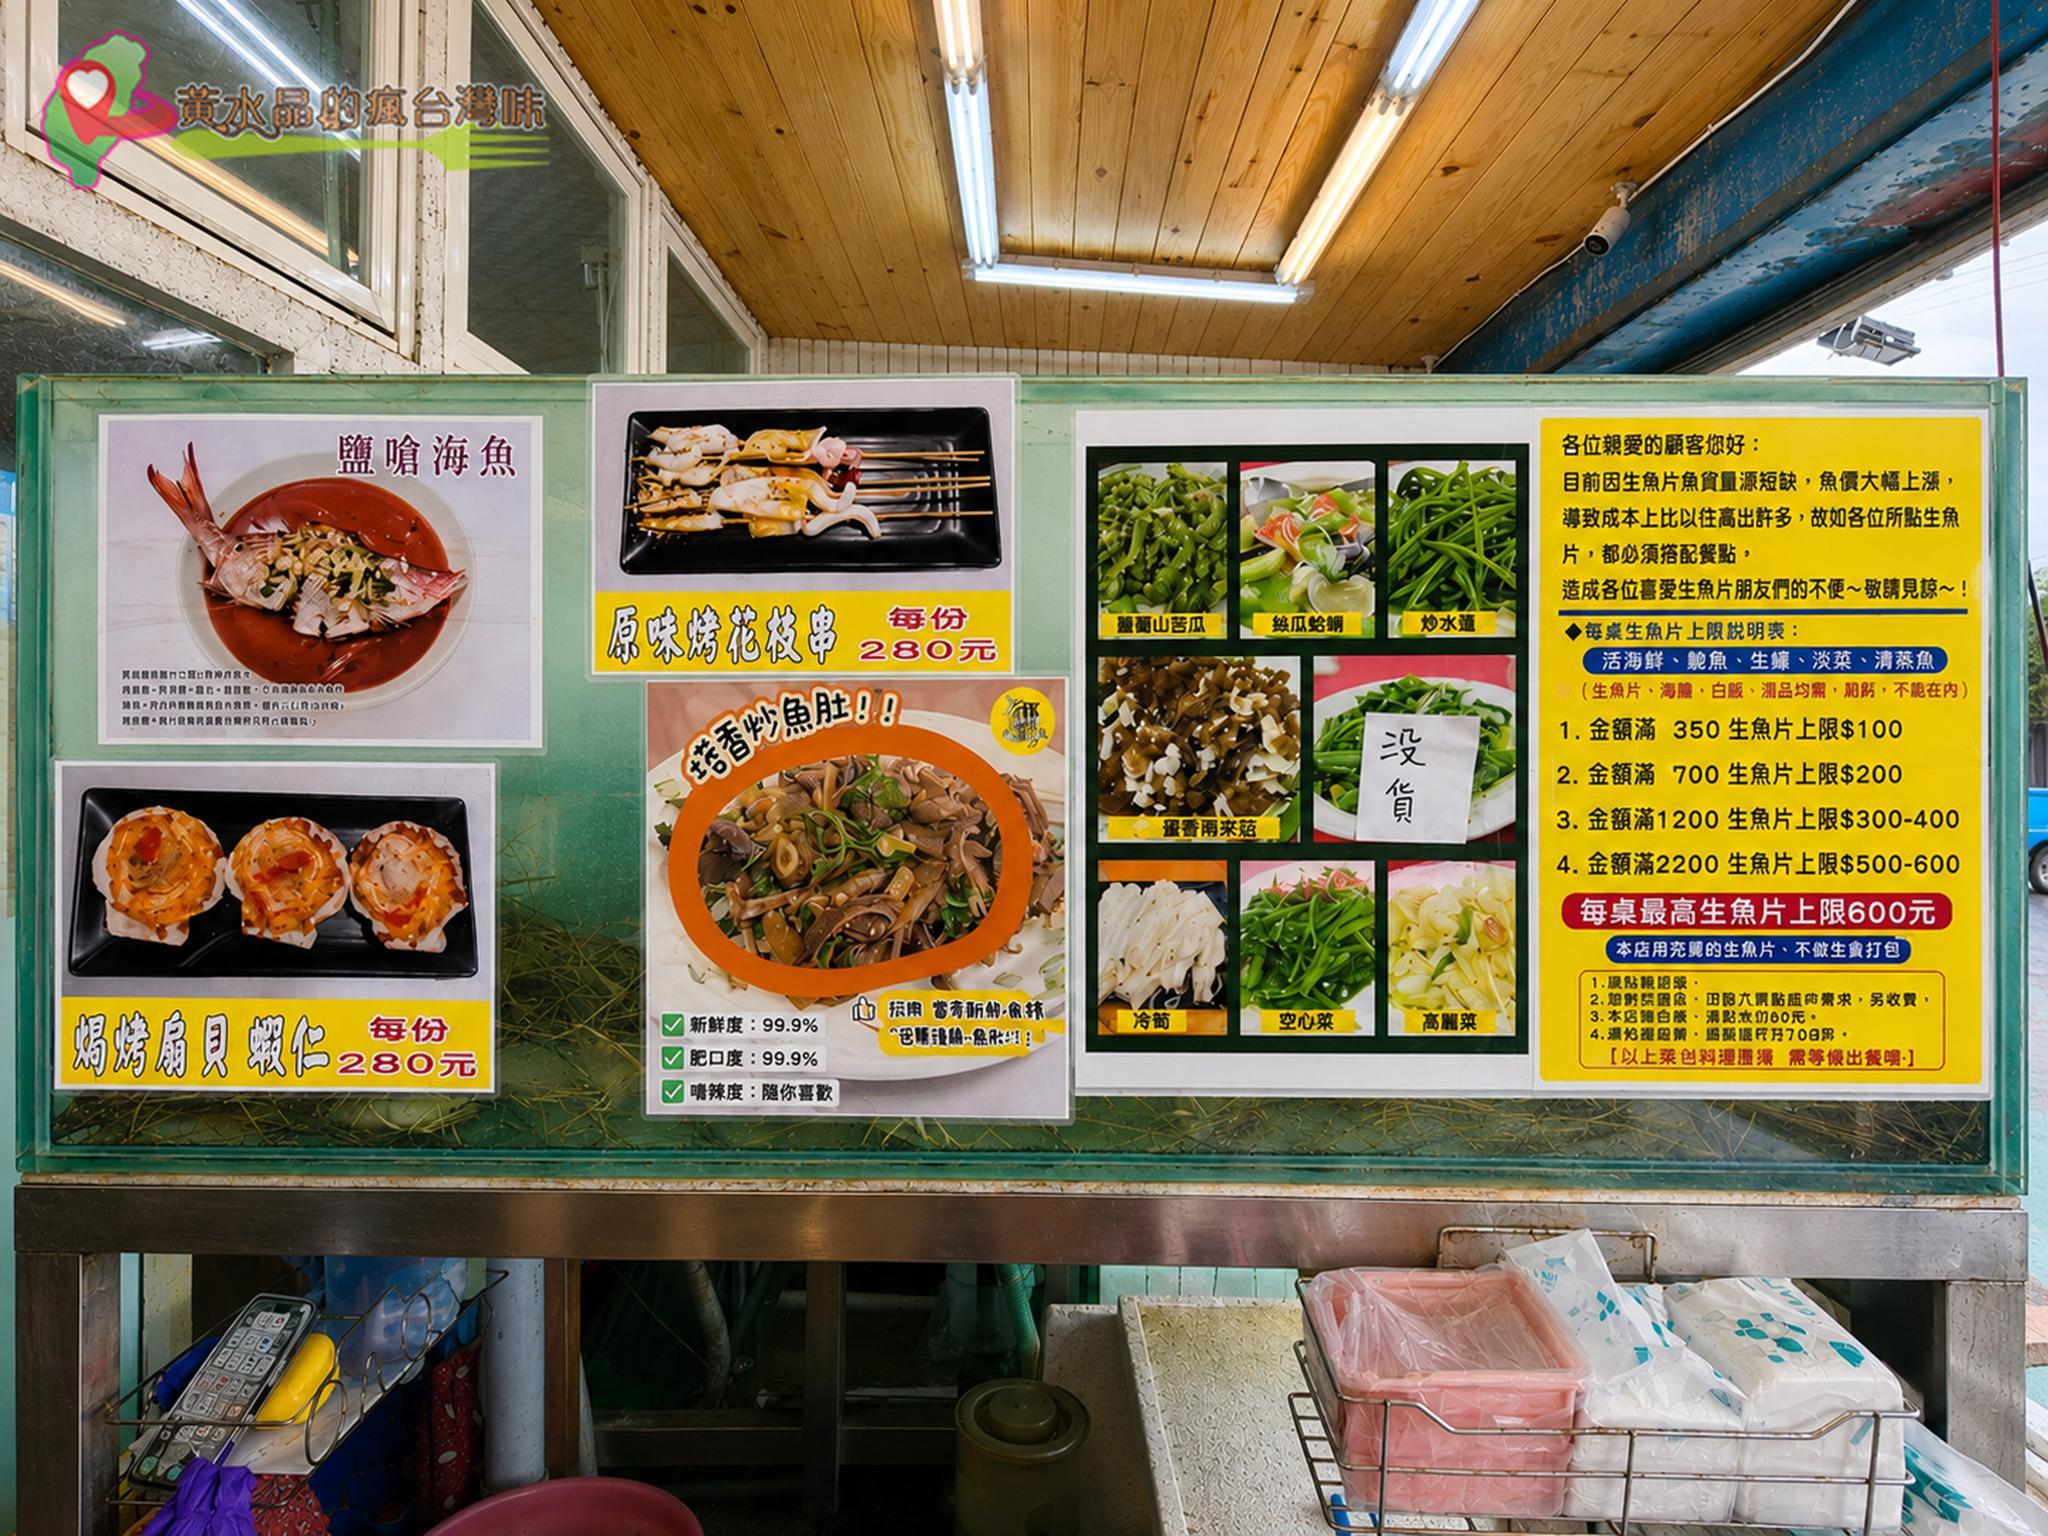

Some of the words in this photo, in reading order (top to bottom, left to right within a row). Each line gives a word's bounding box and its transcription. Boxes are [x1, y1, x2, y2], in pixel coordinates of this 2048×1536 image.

[888, 606, 967, 631] 每份
[607, 604, 838, 665] 原味烤花枝串
[859, 639, 998, 663] 280元
[1589, 717, 1656, 741] 金額滿
[1673, 720, 1720, 741] 350
[1728, 717, 1903, 742] 生魚片上限$100
[1588, 762, 1655, 786] 金額滿
[1673, 765, 1719, 785] 700
[1728, 762, 1903, 786] 生魚片上限$200
[1588, 807, 1719, 831] 金額滿1200
[1728, 807, 1960, 832] 生魚片上限$300-400
[1588, 852, 1719, 876] 金額滿2200
[1728, 852, 1960, 876] 生魚片上限$500-600
[1580, 899, 1936, 926] 每桌最高生魚片上限600元
[368, 1015, 450, 1043] 每份
[690, 1016, 819, 1033] 新鮮度：99.9%
[1279, 1011, 1335, 1031] 空心菜
[1422, 1011, 1477, 1031] 高麗菜
[73, 1009, 229, 1079] 焗烤扇貝
[248, 1014, 330, 1078] 蝦仁
[337, 1051, 479, 1079] 280元
